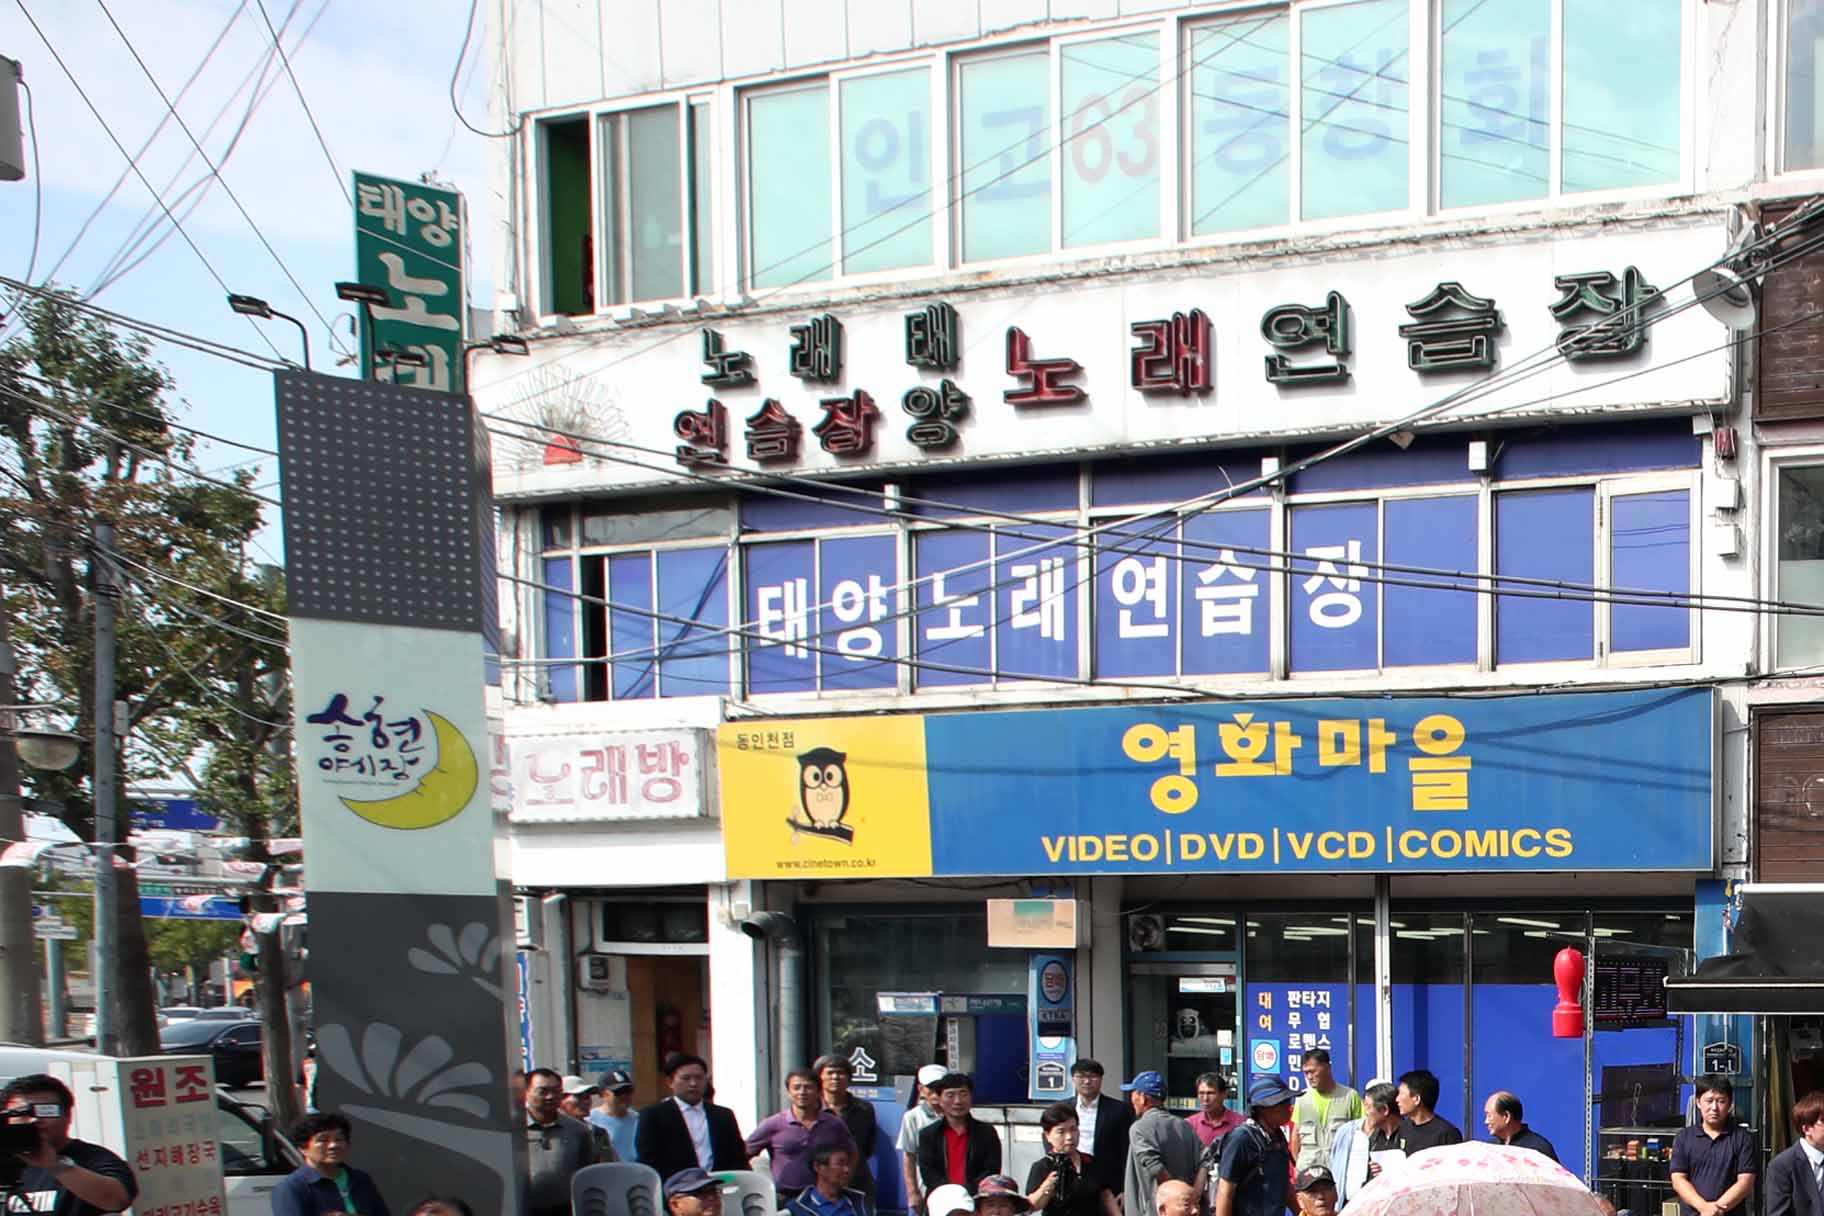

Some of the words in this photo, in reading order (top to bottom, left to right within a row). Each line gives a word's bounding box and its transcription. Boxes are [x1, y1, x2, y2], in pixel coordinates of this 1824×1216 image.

[357, 183, 459, 248] 태양
[701, 312, 846, 386] 노래
[674, 388, 881, 466] 연습장
[737, 732, 794, 750] 동인천점
[318, 754, 421, 780] 야시장
[1122, 712, 1472, 815] 영화마을
[1042, 833, 1159, 862] VIDEO
[1181, 832, 1265, 861] DVD
[1287, 830, 1376, 860] VCD
[1399, 828, 1575, 859] COMICS
[1288, 991, 1331, 1009] 판타지
[1288, 1033, 1331, 1051] 로맨스
[130, 1066, 210, 1108] 원조
